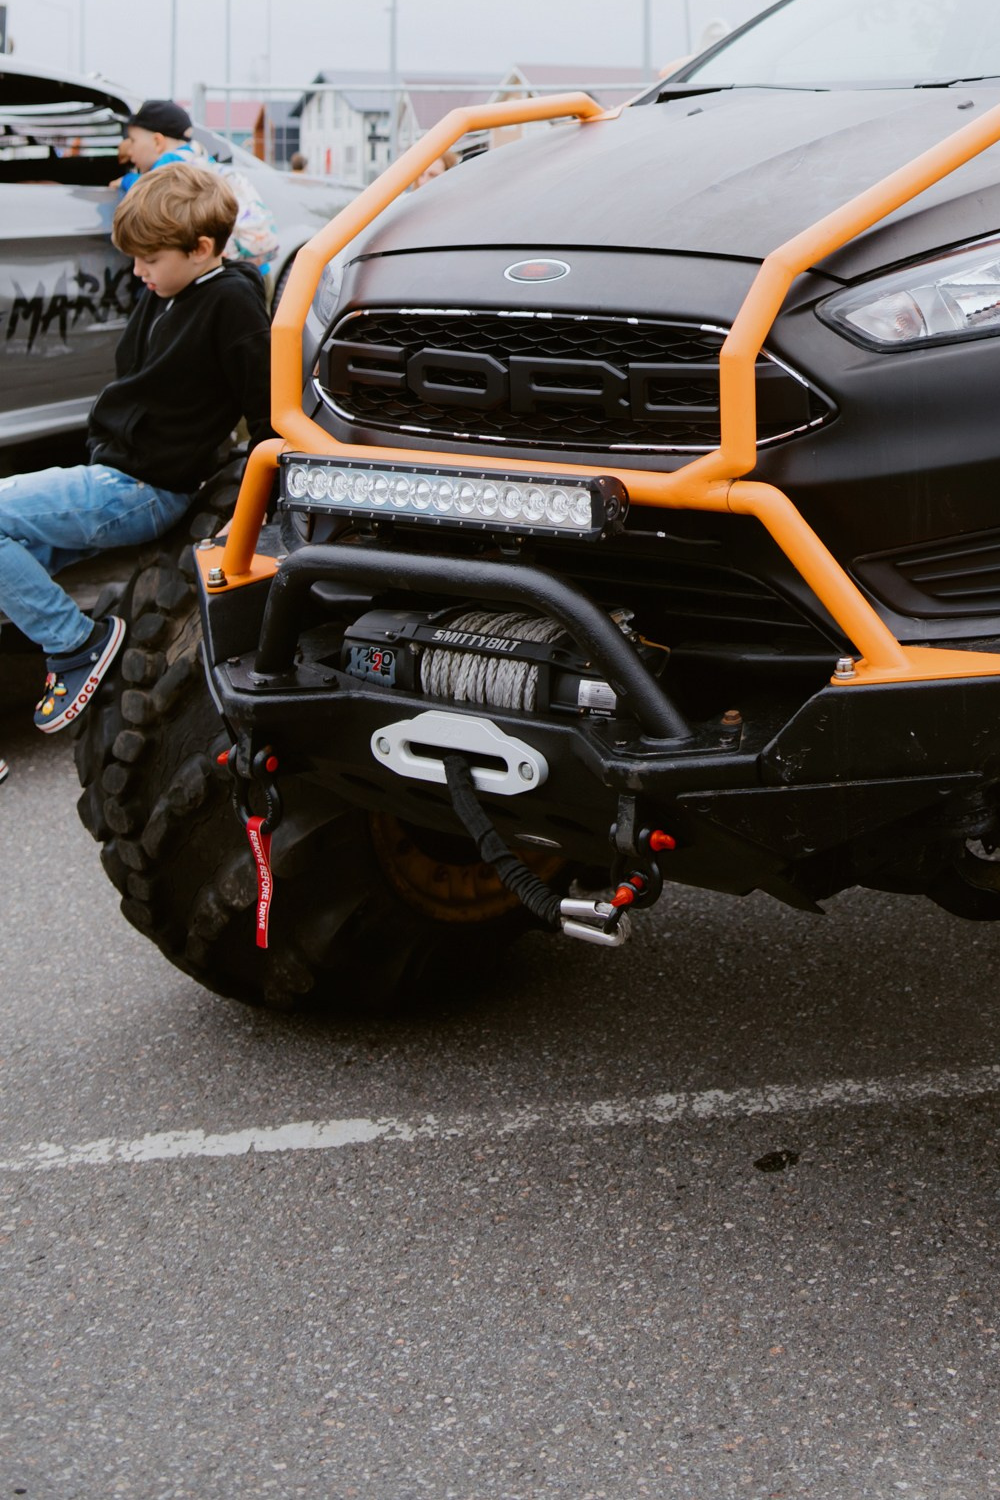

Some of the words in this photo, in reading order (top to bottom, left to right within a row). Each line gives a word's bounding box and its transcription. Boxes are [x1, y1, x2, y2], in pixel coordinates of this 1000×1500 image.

[5, 266, 135, 355] MARK
[319, 338, 810, 422] FORD
[432, 629, 522, 652] SMITTYBILT
[65, 676, 99, 720] crocs
[249, 829, 266, 865] REMOVE
[260, 864, 271, 901] BEFORE
[258, 901, 268, 930] DRIVE
